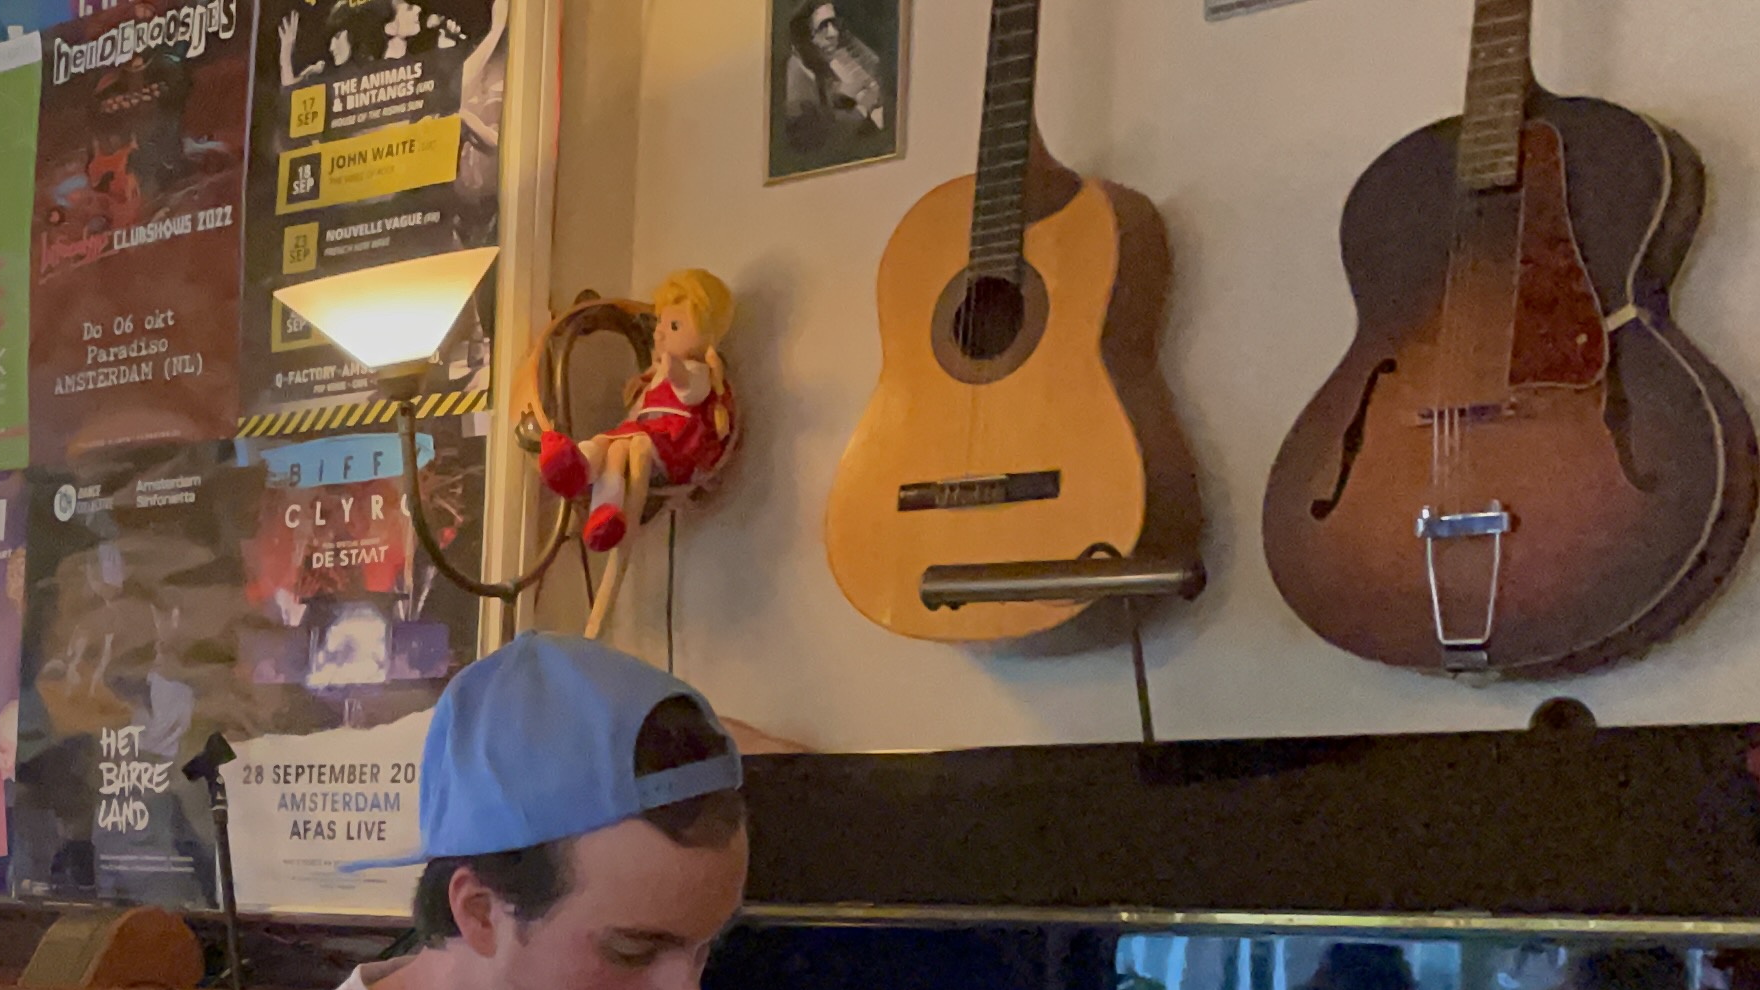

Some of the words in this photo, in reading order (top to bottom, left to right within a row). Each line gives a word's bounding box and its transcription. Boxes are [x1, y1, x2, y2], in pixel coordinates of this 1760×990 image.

[333, 78, 357, 97] THE
[361, 62, 423, 90] ANIMALS
[302, 98, 315, 111] 17
[347, 80, 415, 110] BINTANGS
[297, 111, 319, 127] SEP
[329, 152, 368, 175] JOHN
[371, 139, 416, 162] WAITE
[298, 164, 311, 179] 18
[292, 177, 315, 195] SEP
[113, 213, 192, 250] CLUBSHOWS
[197, 205, 233, 231] 2022
[325, 220, 383, 242] NOUVELLE
[385, 212, 423, 230] VAGUE
[289, 248, 310, 264] SEP
[82, 322, 103, 341] Do
[113, 314, 134, 335] 06
[144, 308, 175, 331] okt
[286, 319, 309, 334] SEP
[86, 337, 169, 364] Paradiso
[54, 361, 153, 395] AMSTERDAM
[164, 353, 203, 381] (NL)
[289, 451, 385, 487] BIFF
[135, 475, 201, 493] Amsterdam
[312, 551, 334, 569] DE
[339, 545, 390, 567] STAAT
[99, 725, 146, 759] HET
[98, 760, 174, 798] BARRE
[242, 764, 264, 785] 28
[272, 763, 381, 785] SEPTEMBER
[390, 763, 416, 785] 20
[98, 797, 149, 834] LAND
[277, 792, 401, 813] AMSTERDAM
[289, 820, 337, 840] AFAS
[346, 820, 386, 841] LIVE
